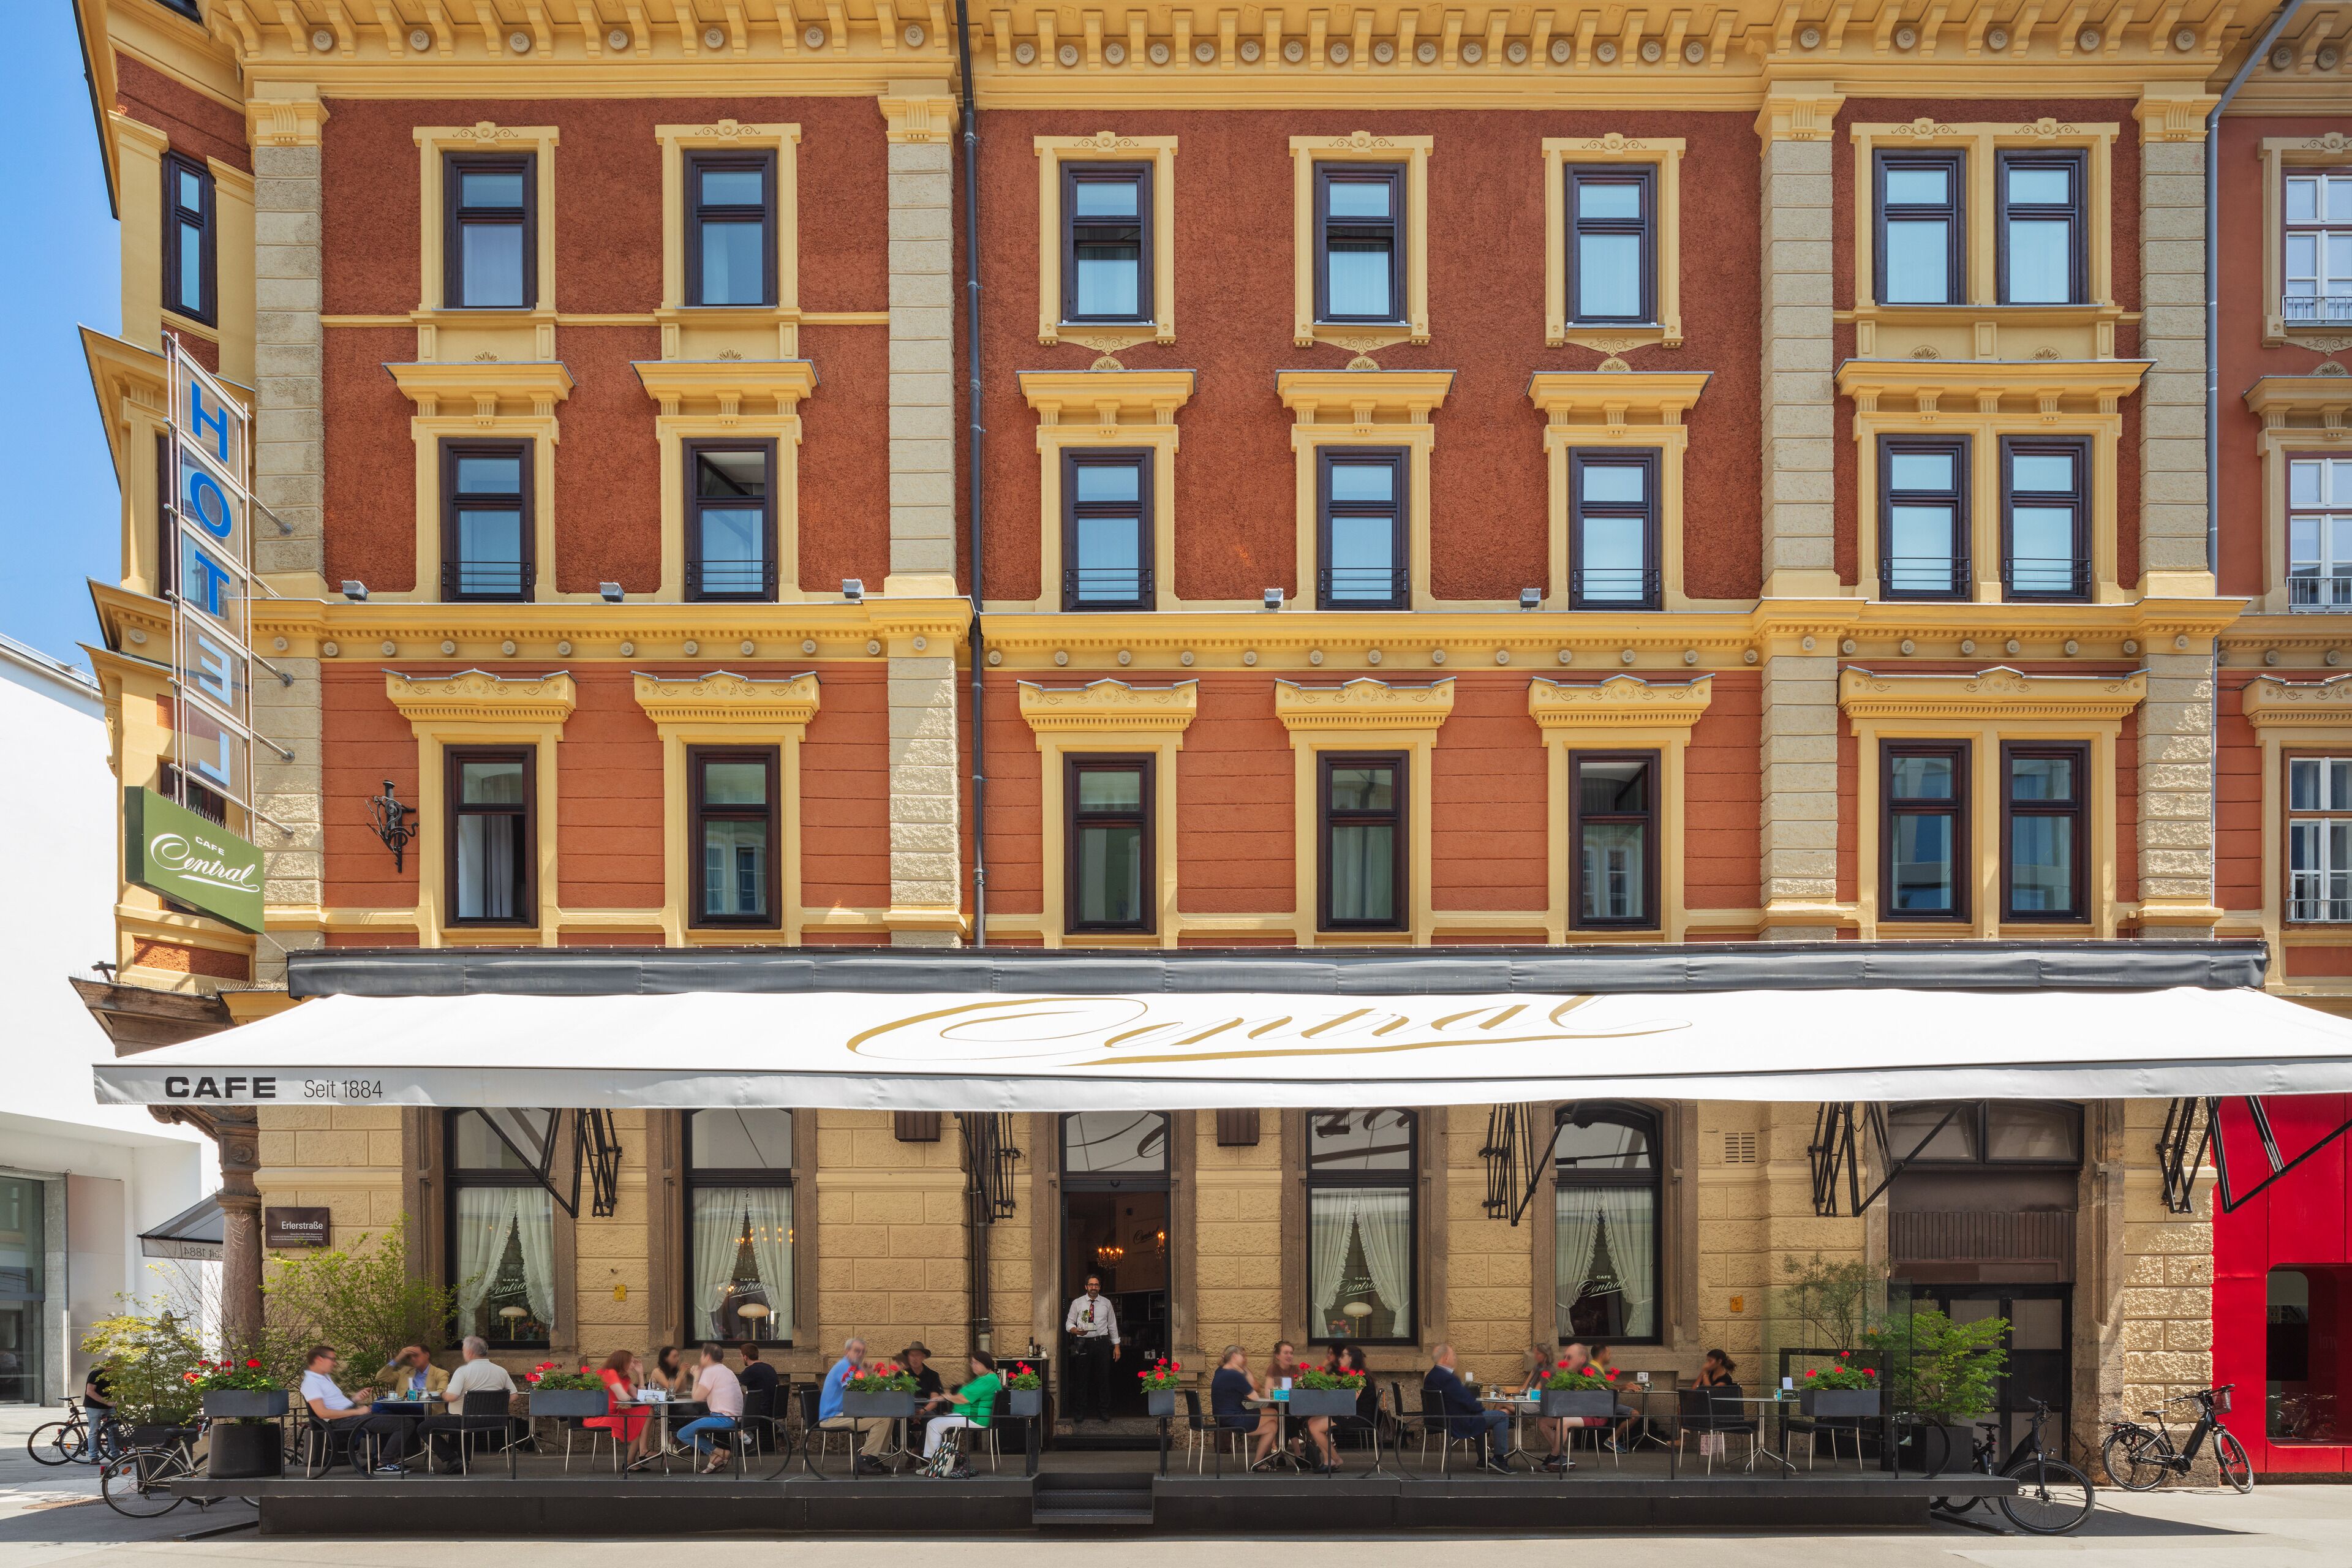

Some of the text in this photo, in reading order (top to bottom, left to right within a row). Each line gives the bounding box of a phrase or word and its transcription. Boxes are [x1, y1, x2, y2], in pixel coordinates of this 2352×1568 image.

[195, 835, 225, 856] CAFE
[150, 833, 260, 892] Central
[846, 993, 1693, 1068] Central
[165, 1076, 383, 1098] CAFE Seit 1884
[281, 1221, 323, 1230] Erlerstraße
[1575, 1276, 1630, 1298] Central
